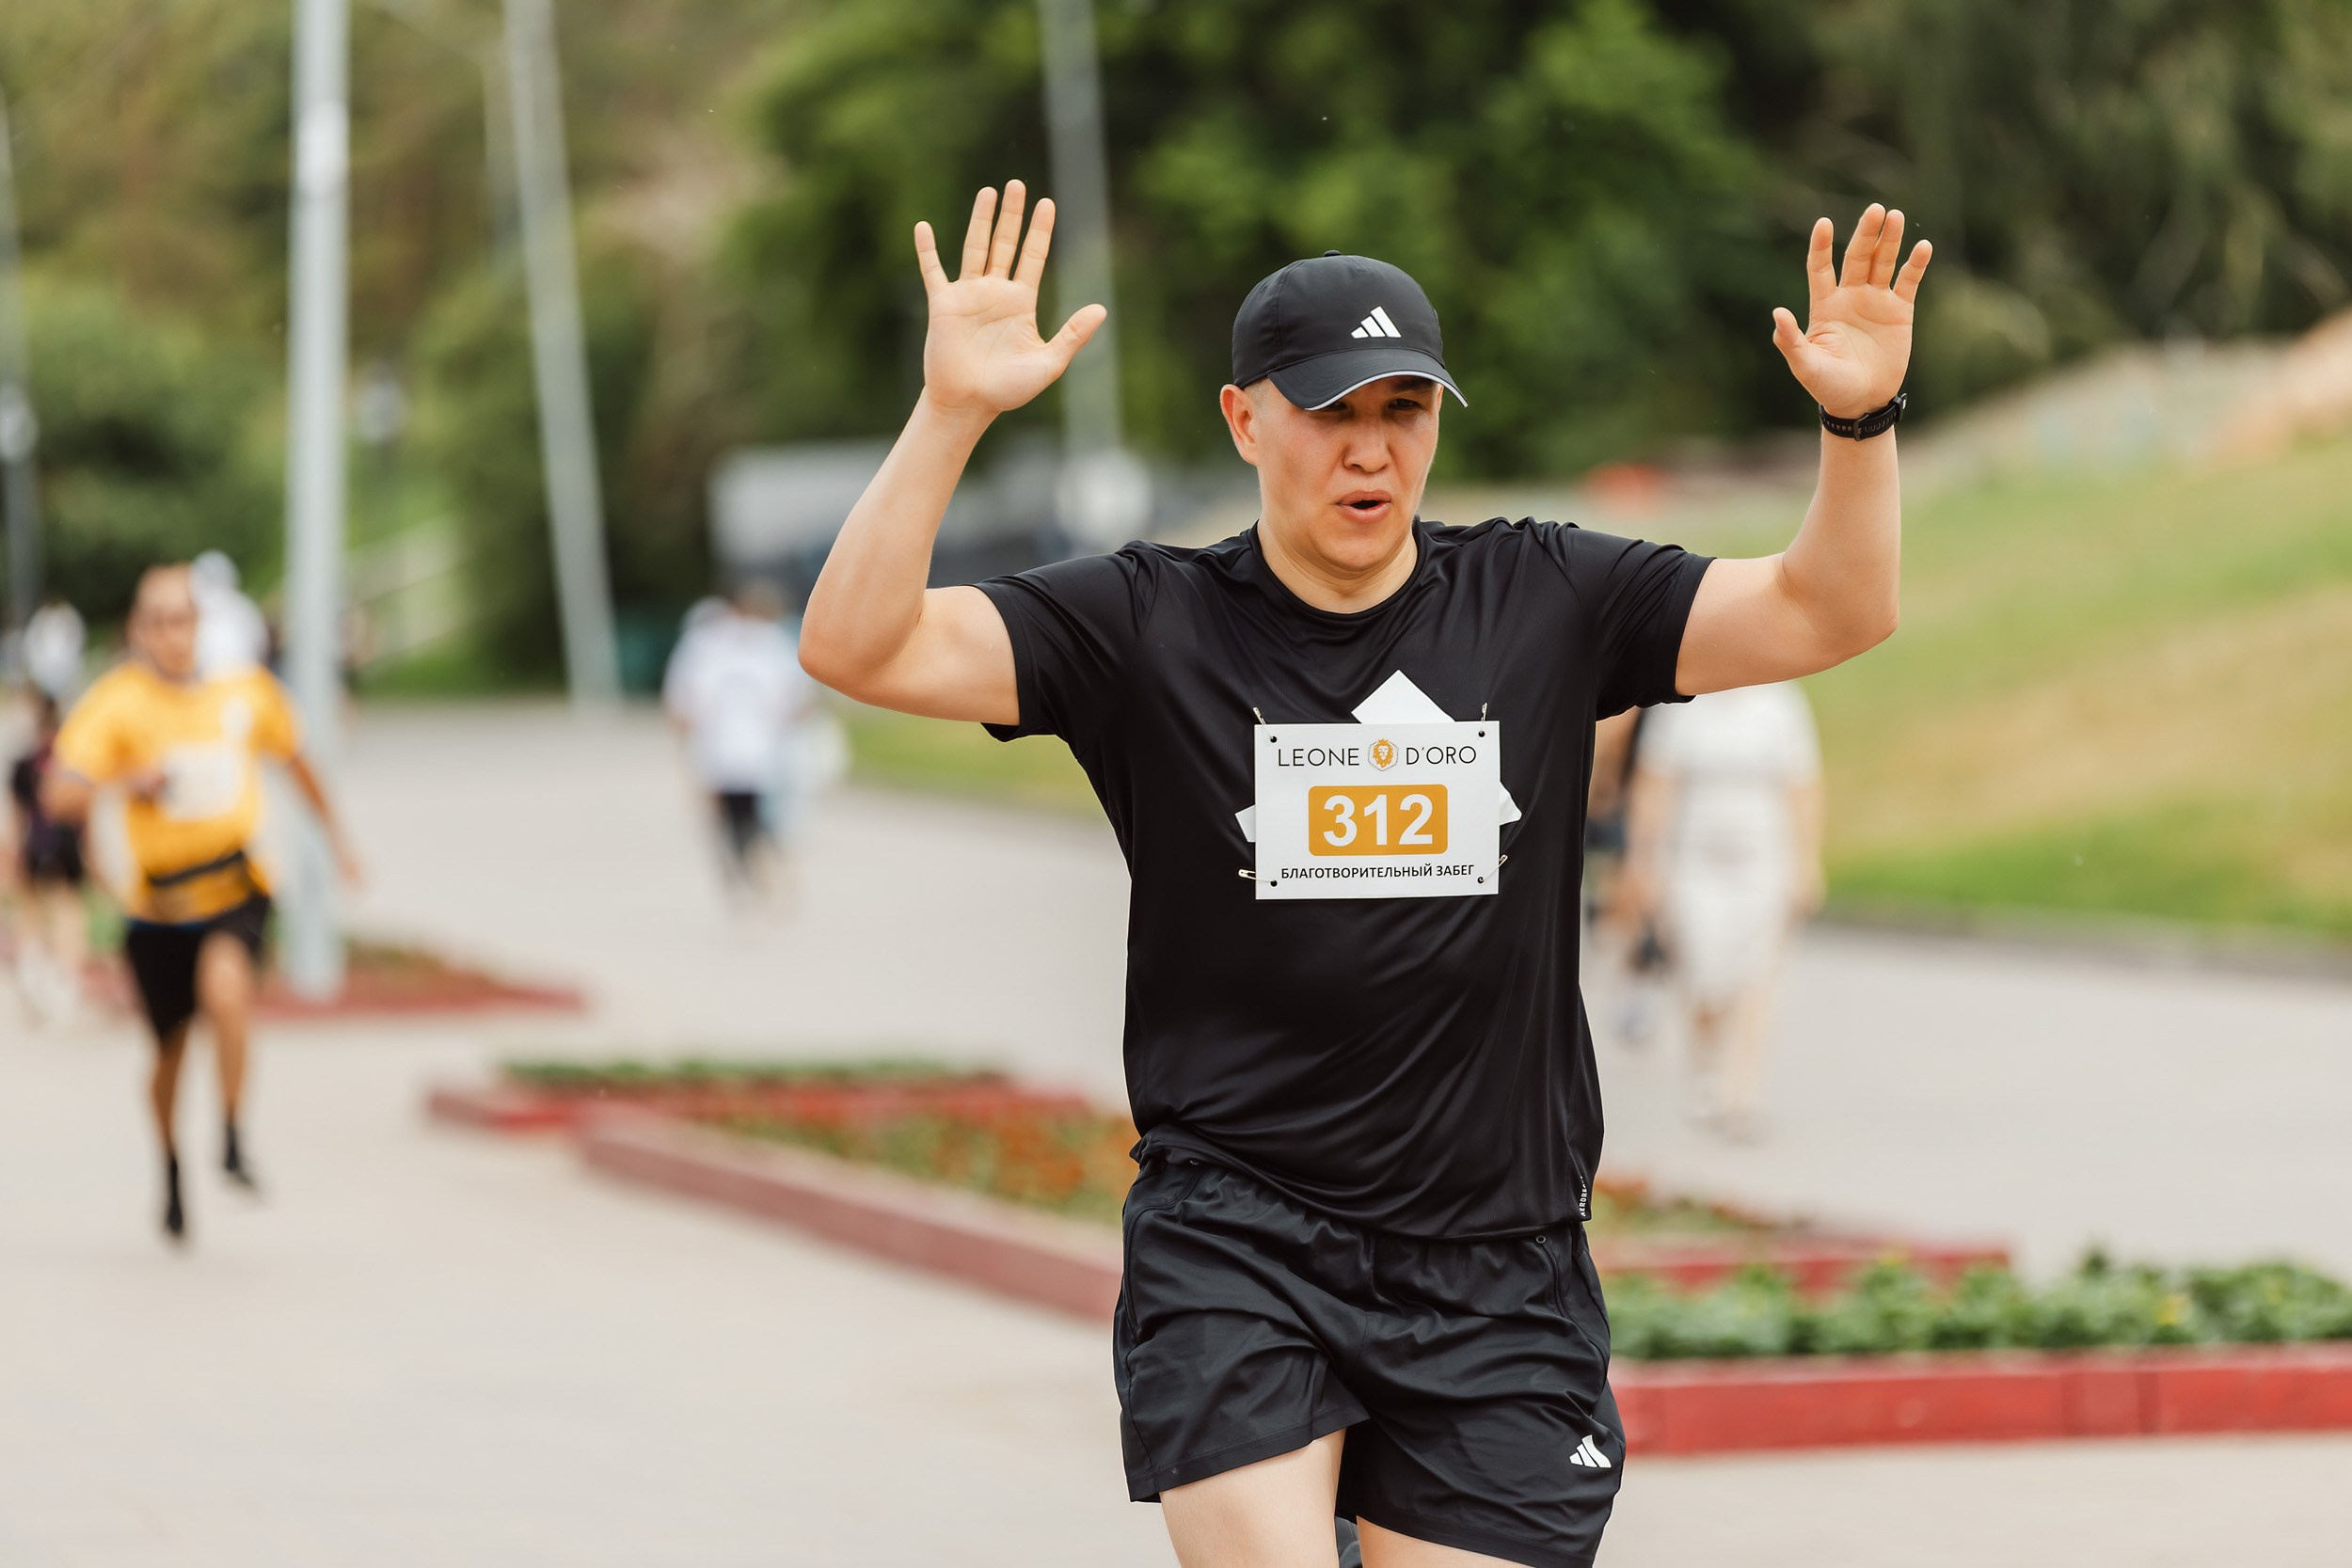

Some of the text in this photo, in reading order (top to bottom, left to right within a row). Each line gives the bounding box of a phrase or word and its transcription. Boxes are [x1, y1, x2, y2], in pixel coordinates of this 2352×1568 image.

[1278, 746, 1477, 767] LEONE D'ORO
[1323, 794, 1433, 847] 312
[1280, 863, 1474, 879] БЛАГОТВОРИТЕЛЬНЫЙ ЗАБЕГ
